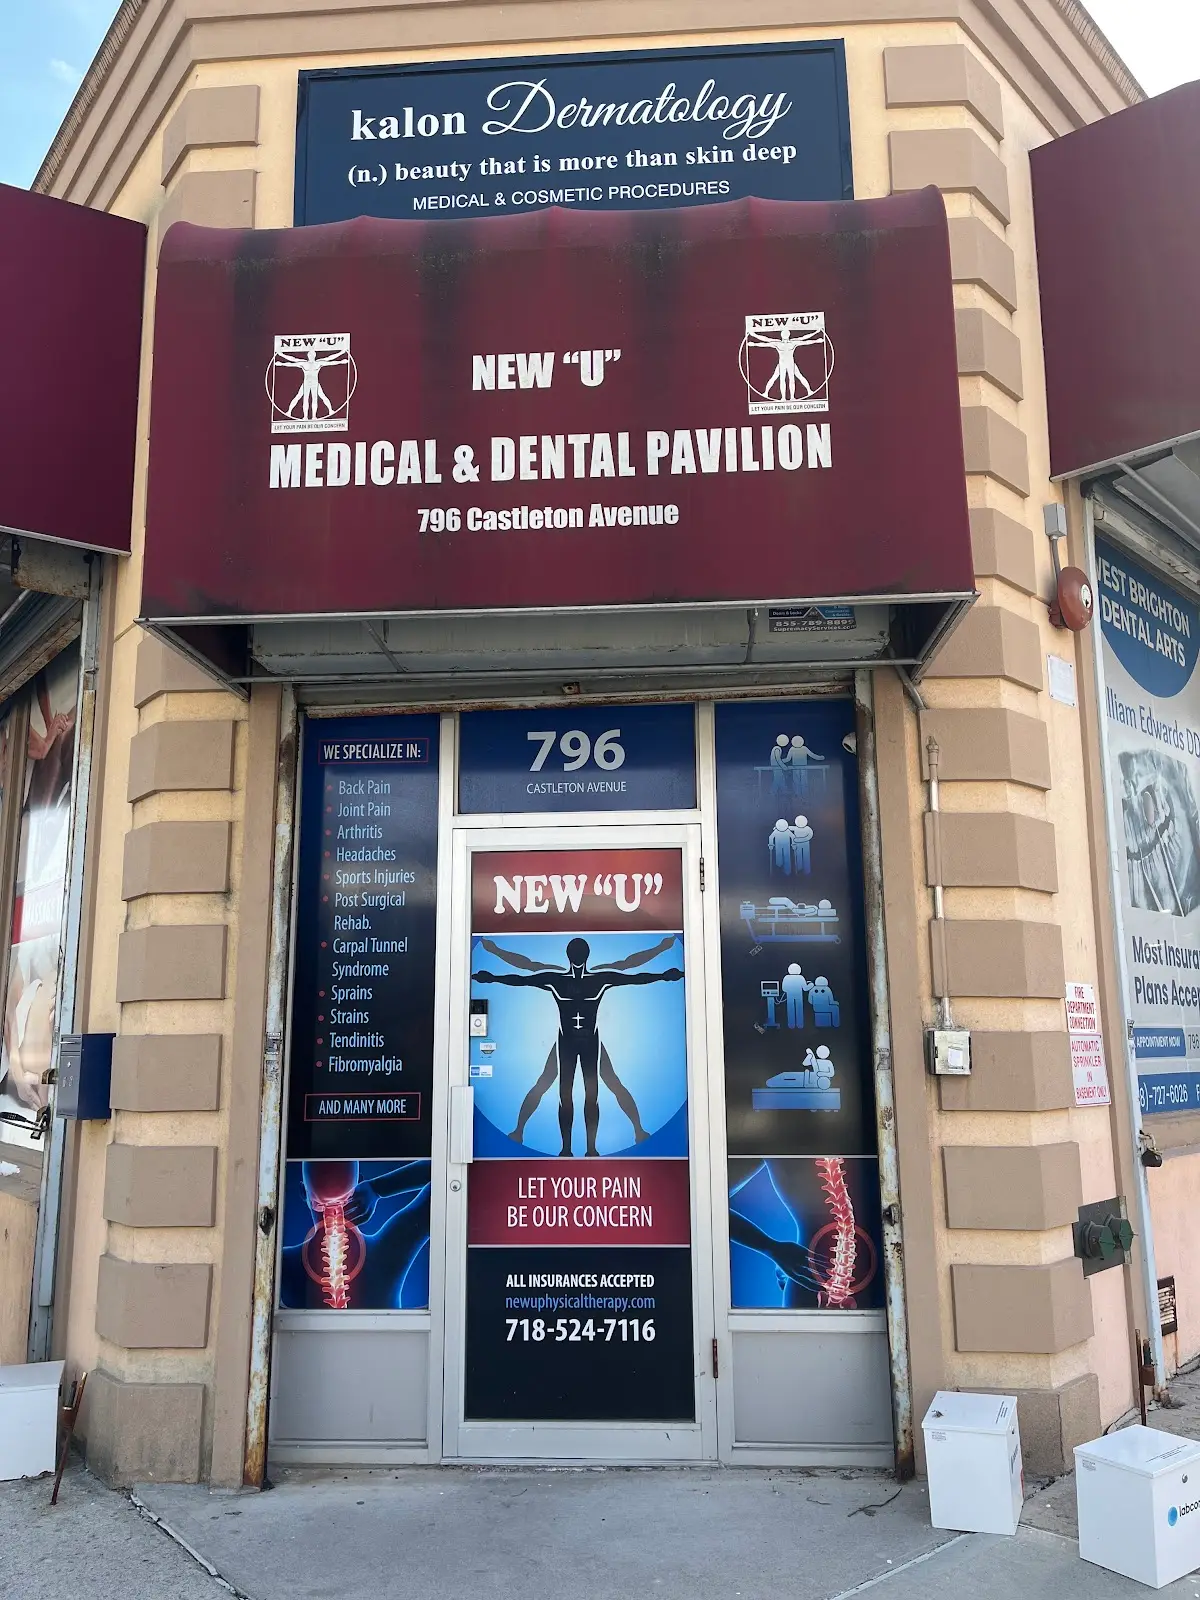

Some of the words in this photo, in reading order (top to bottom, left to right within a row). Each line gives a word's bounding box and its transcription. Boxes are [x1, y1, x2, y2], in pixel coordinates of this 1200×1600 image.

[350, 106, 467, 141] kalon
[481, 78, 793, 140] Dermatology
[348, 163, 388, 187] (n.)
[395, 161, 472, 182] beauty
[479, 157, 526, 176] that
[533, 154, 551, 174] is
[559, 152, 618, 172] more
[625, 148, 678, 168] than
[685, 145, 734, 165] skin
[742, 143, 798, 165] deep
[413, 193, 490, 211] MEDICAL
[494, 192, 507, 206] &
[511, 185, 603, 205] COSMETIC
[608, 180, 731, 200] PROCEDURES
[752, 317, 789, 327] NEW
[280, 338, 316, 347] NEW
[471, 351, 555, 392] NEW
[562, 348, 622, 388] “U”
[268, 438, 442, 490] MEDICAL
[452, 444, 480, 484] &
[490, 431, 637, 483] DENTAL
[646, 422, 834, 477] PAVILION
[417, 507, 462, 534] 796
[466, 504, 583, 532] Castleton
[588, 502, 680, 528] Avenue
[1128, 575, 1191, 639] BRIGHTON
[1101, 593, 1155, 649] DENTAL
[1155, 628, 1186, 667] ARTS
[1105, 686, 1137, 730] lliam
[1139, 704, 1185, 751] Edwards
[323, 744, 341, 760] WE
[342, 743, 403, 760] SPECIALIZE
[406, 743, 421, 758] IN:
[526, 728, 626, 772] 796
[338, 780, 365, 795] Back
[367, 779, 391, 794] Pain
[526, 782, 585, 794] CASTLETON
[586, 781, 627, 793] AVENUE
[337, 802, 365, 817] Joint
[367, 802, 391, 816] Pain
[337, 824, 383, 840] Arthritis
[336, 846, 396, 862] Headaches
[335, 869, 371, 887] Sports
[374, 868, 416, 887] Injuries
[334, 892, 358, 908] Post
[361, 890, 405, 911] Surgical
[492, 874, 588, 914] NEW
[593, 872, 664, 913] “U”
[334, 914, 372, 930] Rehab.
[332, 937, 368, 957] Carpal
[370, 936, 408, 953] Tunnel
[1131, 935, 1164, 966] Most
[1164, 939, 1200, 970] Insura
[331, 961, 390, 980] Syndrome
[330, 984, 373, 1004] Sprains
[1074, 986, 1085, 999] FIRE
[1134, 975, 1169, 1006] Plans
[329, 1008, 370, 1024] Strains
[1067, 1001, 1095, 1014] DEPARTMENT
[1069, 1016, 1096, 1030] CONNECTION
[329, 1031, 385, 1049] Tendinitis
[1071, 1040, 1100, 1052] AUTOMATIC
[1136, 1036, 1169, 1048] APPOINTMENT
[1169, 1035, 1181, 1048] NOW
[328, 1055, 403, 1075] Fibromyalgia
[1073, 1055, 1102, 1068] SPRINKLER
[1086, 1071, 1093, 1083] IN
[1076, 1086, 1096, 1099] BASEMENT
[318, 1100, 341, 1115] AND
[343, 1099, 375, 1115] MANY
[376, 1099, 407, 1114] MORE
[518, 1177, 547, 1199] LET
[550, 1176, 597, 1199] YOUR
[602, 1176, 641, 1199] PAIN
[507, 1205, 528, 1227] BE
[532, 1205, 569, 1227] OUR
[573, 1205, 653, 1227] CONCERN
[505, 1274, 526, 1288] ALL
[528, 1274, 598, 1288] INSURANCES
[600, 1274, 655, 1288] ACCEPTED
[505, 1293, 656, 1312] newuphysicaltherapy.com
[505, 1318, 656, 1342] 718-524-7116
